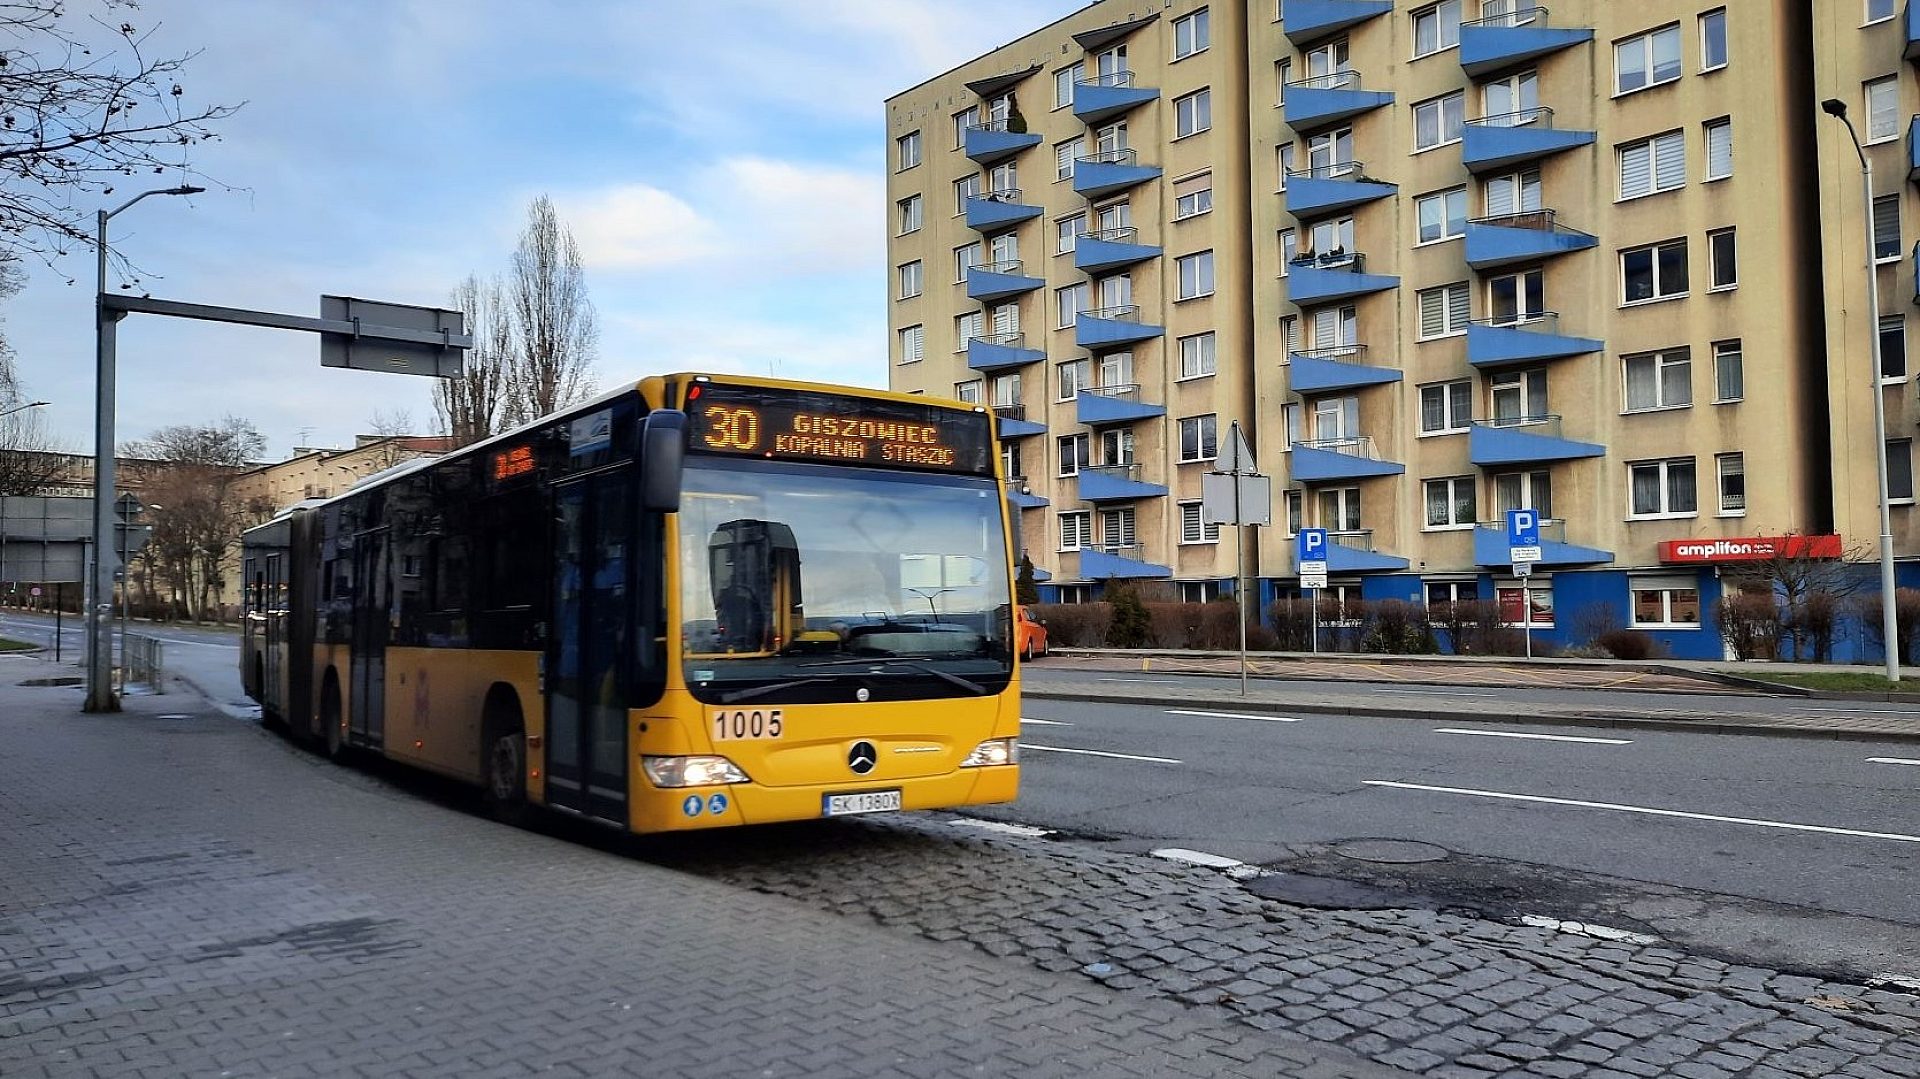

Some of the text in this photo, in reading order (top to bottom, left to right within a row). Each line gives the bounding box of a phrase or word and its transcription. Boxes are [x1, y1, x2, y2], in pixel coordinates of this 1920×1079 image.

[704, 406, 757, 450] 30
[793, 413, 938, 445] GISZOWIEC
[775, 433, 955, 467] KOPALNIA STASZIC
[1515, 512, 1533, 536] P
[1306, 532, 1322, 552] P
[1676, 541, 1752, 559] amplifon
[714, 710, 783, 739] 1005
[831, 792, 900, 813] SK 1380X
